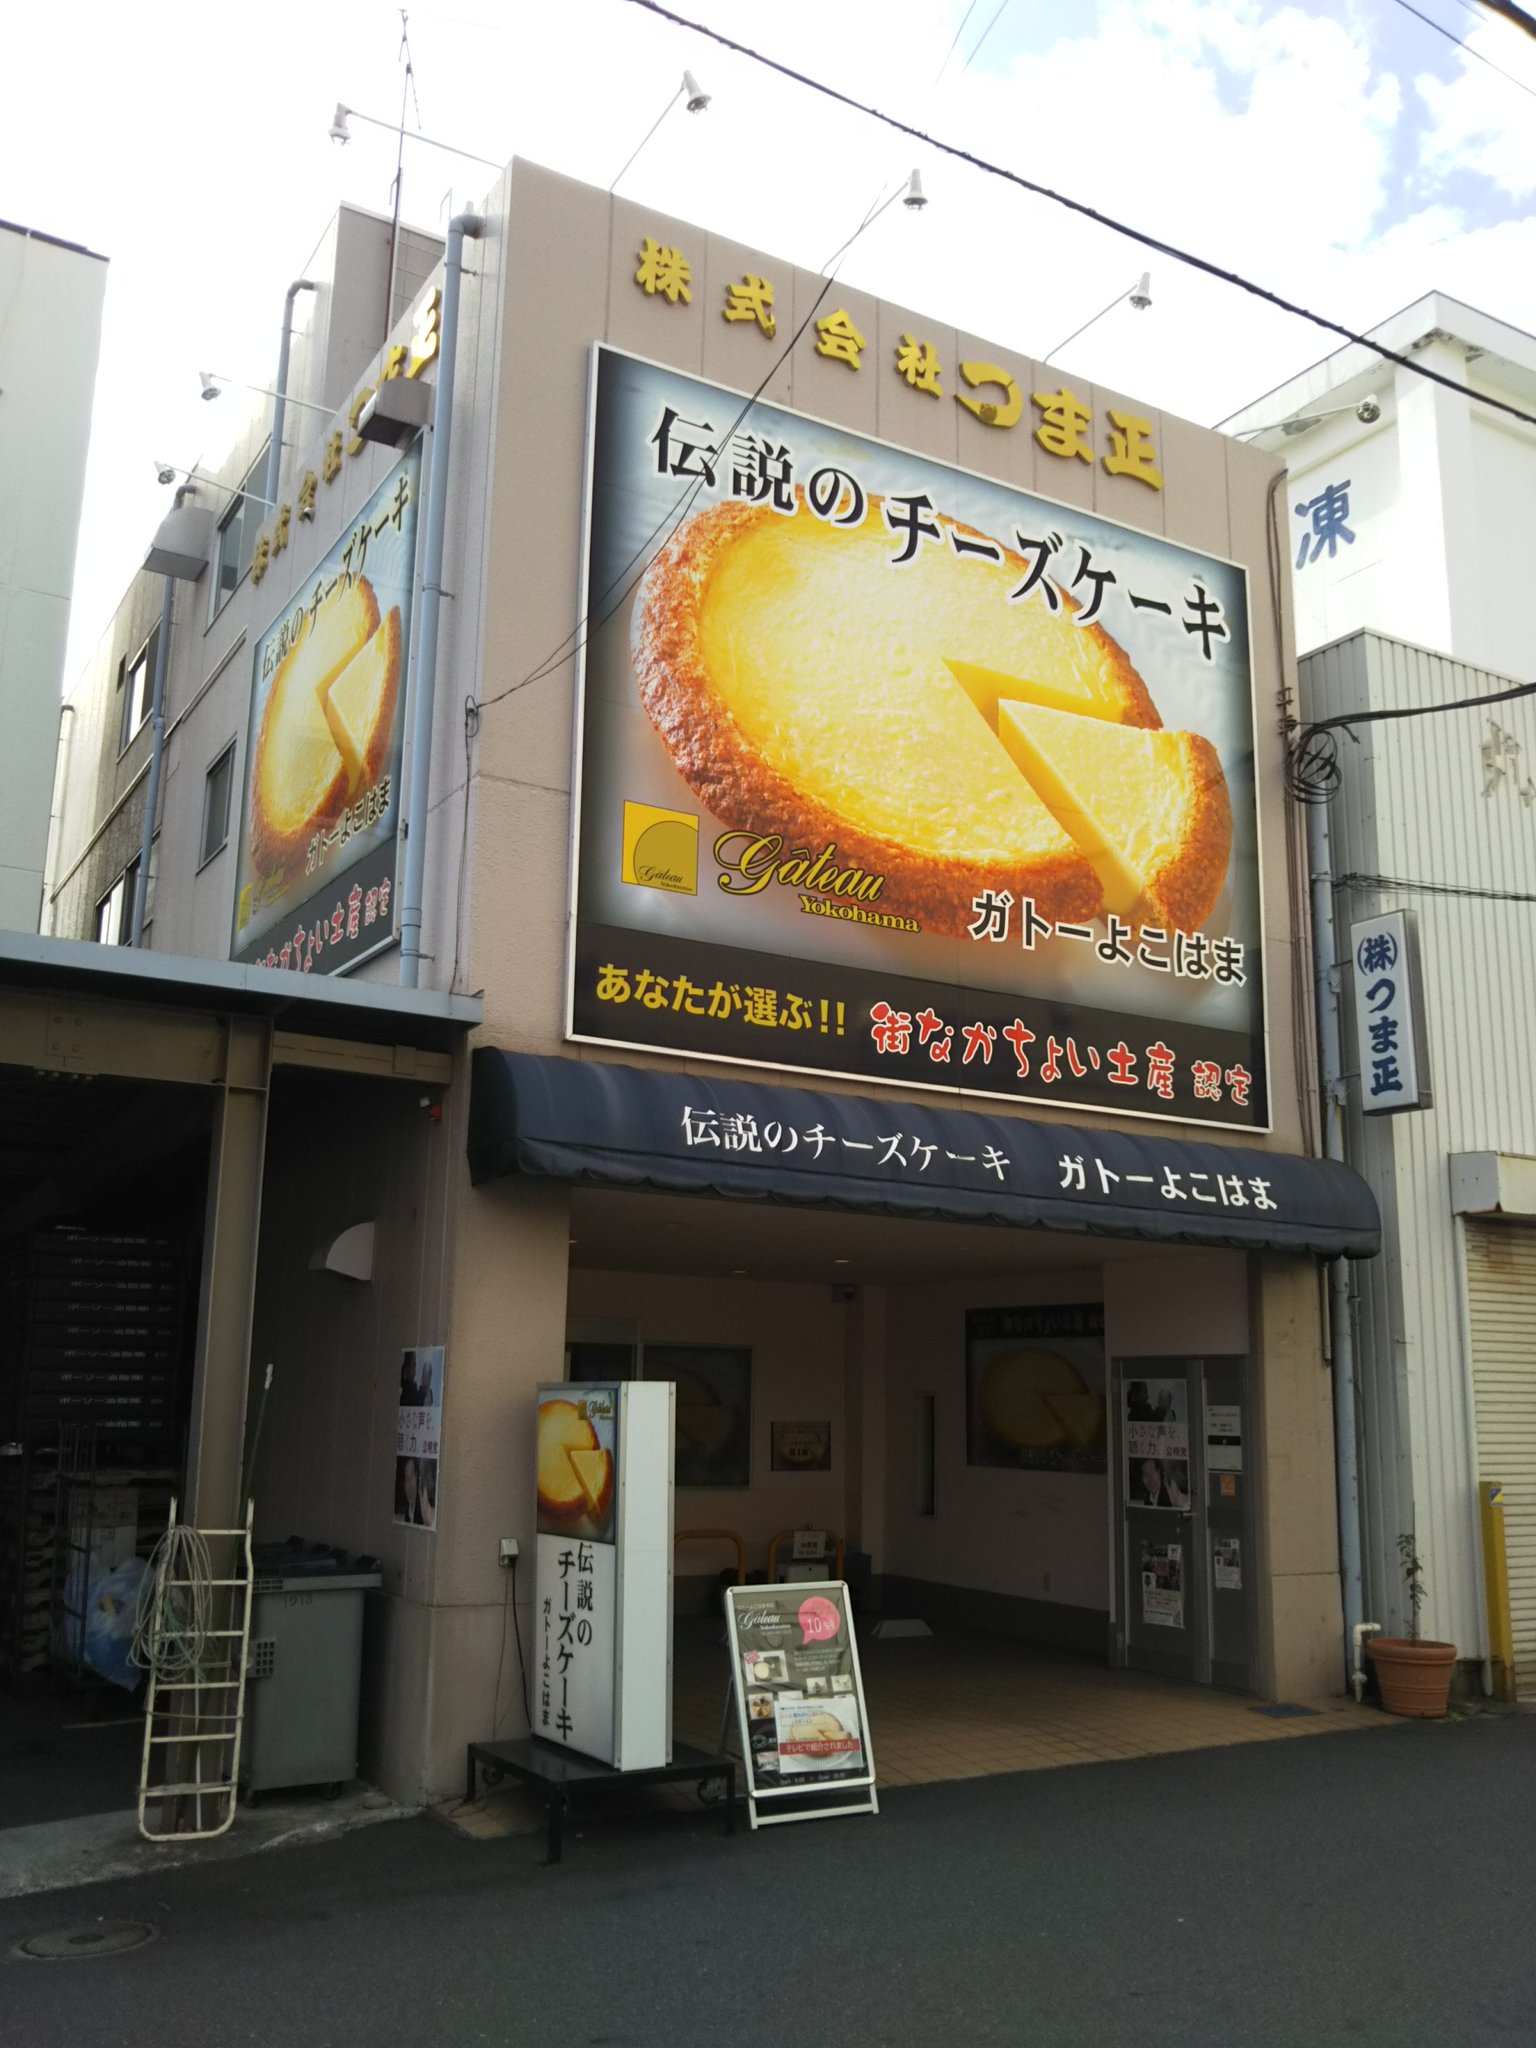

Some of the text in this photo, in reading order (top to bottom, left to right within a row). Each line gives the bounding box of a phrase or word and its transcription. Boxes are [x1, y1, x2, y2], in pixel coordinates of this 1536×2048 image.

[635, 237, 1164, 491] 株式会社つま正
[262, 474, 408, 684] 伝説のチーズケーキ
[652, 406, 1228, 660] 伝説のチーズケーキ
[713, 830, 887, 901] Gâteau
[799, 893, 921, 933] Yokohama
[967, 889, 1248, 987] ガトーよこはま
[870, 1001, 1252, 1106] 街なかちょい土産 認定
[681, 1104, 1278, 1211] 伝説のチーズケーキ ガトーよこはま
[555, 1550, 576, 1741] チーズケーキ
[577, 1542, 594, 1646] 伝説の
[785, 1742, 854, 1753] テレビで紹介されました
